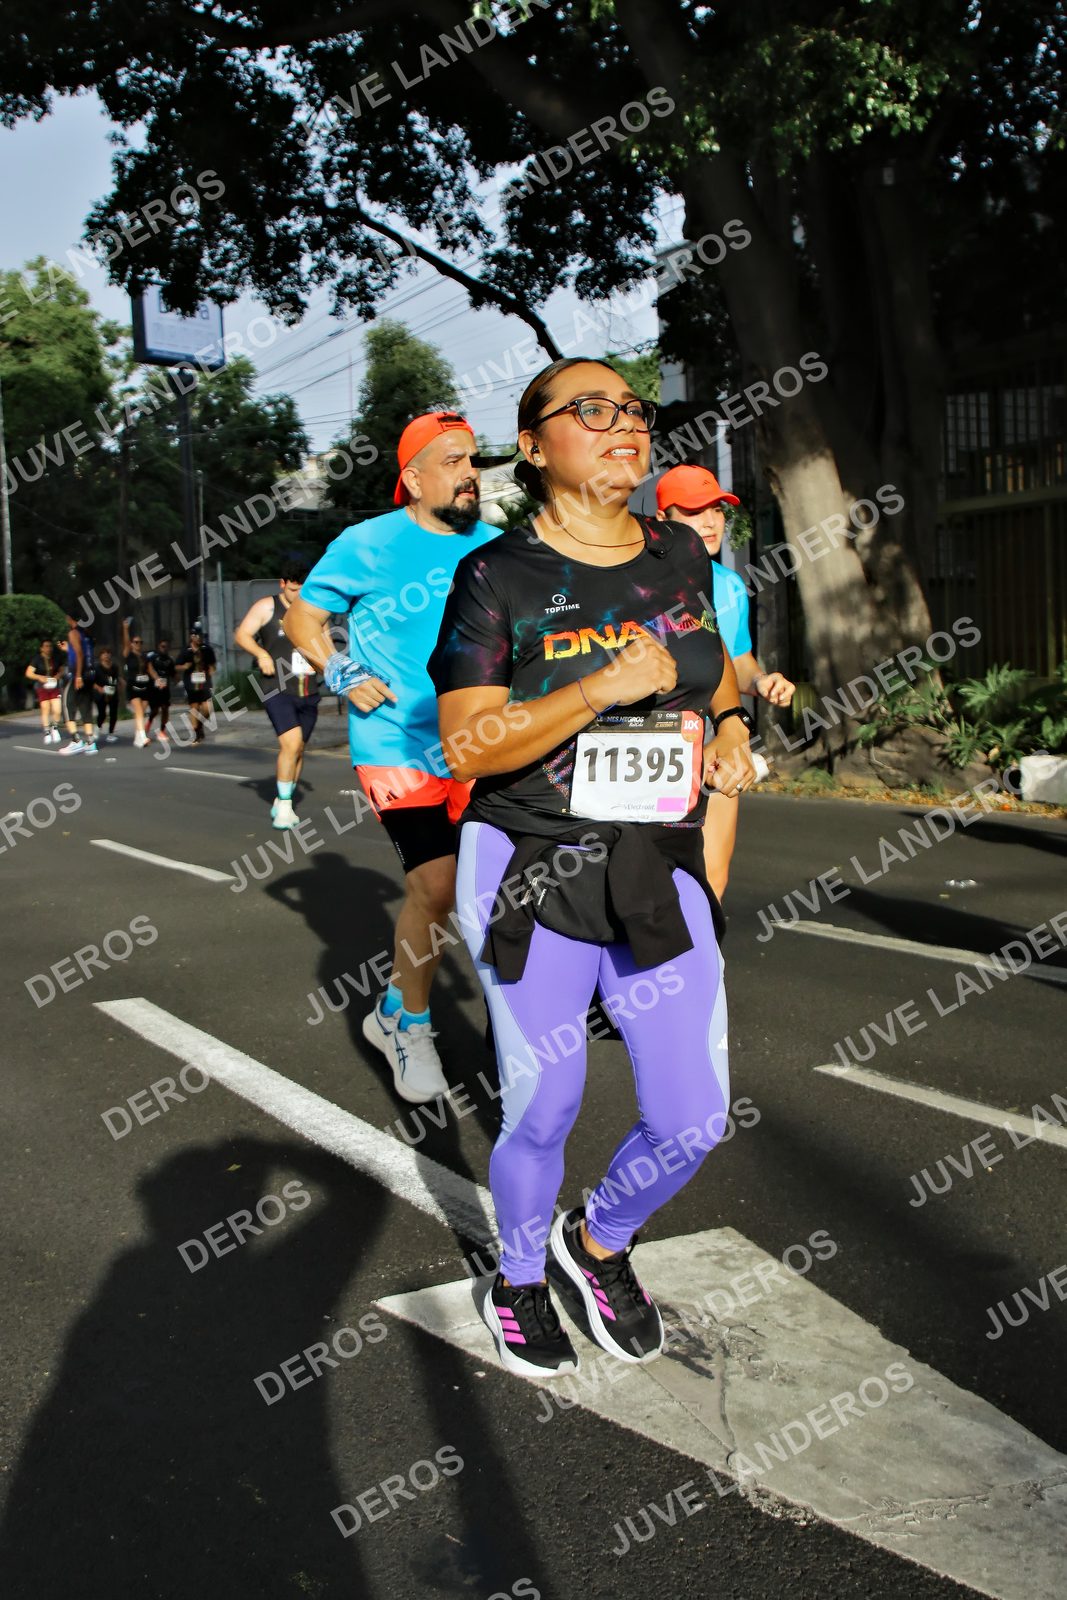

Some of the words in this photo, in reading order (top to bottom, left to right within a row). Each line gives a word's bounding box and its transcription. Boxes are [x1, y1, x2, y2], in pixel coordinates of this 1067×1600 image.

[544, 603, 580, 614] TOPTIME
[544, 620, 647, 661] DNA
[583, 747, 684, 783] 11395
